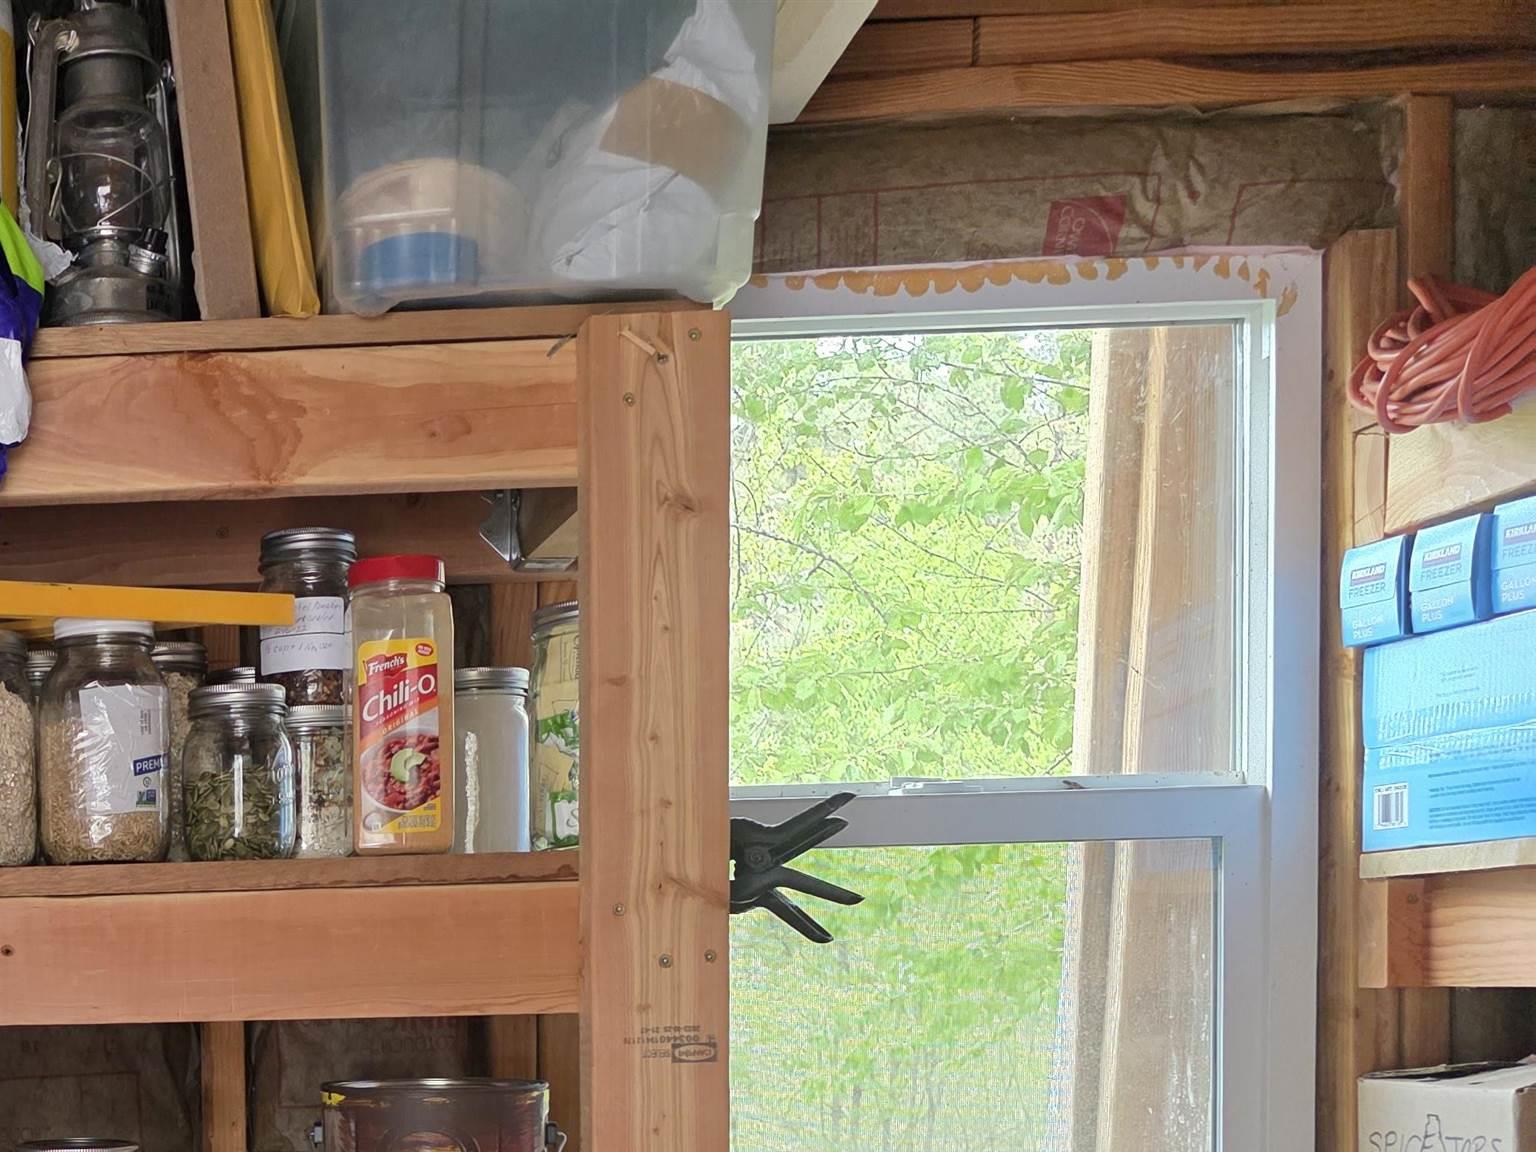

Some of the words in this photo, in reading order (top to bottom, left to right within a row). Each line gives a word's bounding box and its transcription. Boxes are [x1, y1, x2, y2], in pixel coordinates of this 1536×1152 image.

[1423, 545, 1461, 562] KIRKLAND
[1351, 564, 1386, 580] KIRKLAND
[1420, 563, 1463, 582] FREEZER
[1348, 582, 1386, 599] FREEZER
[1501, 590, 1525, 603] PLUS
[1421, 609, 1443, 624] PLUS
[1352, 627, 1374, 640] PLUS
[367, 655, 405, 677] French's
